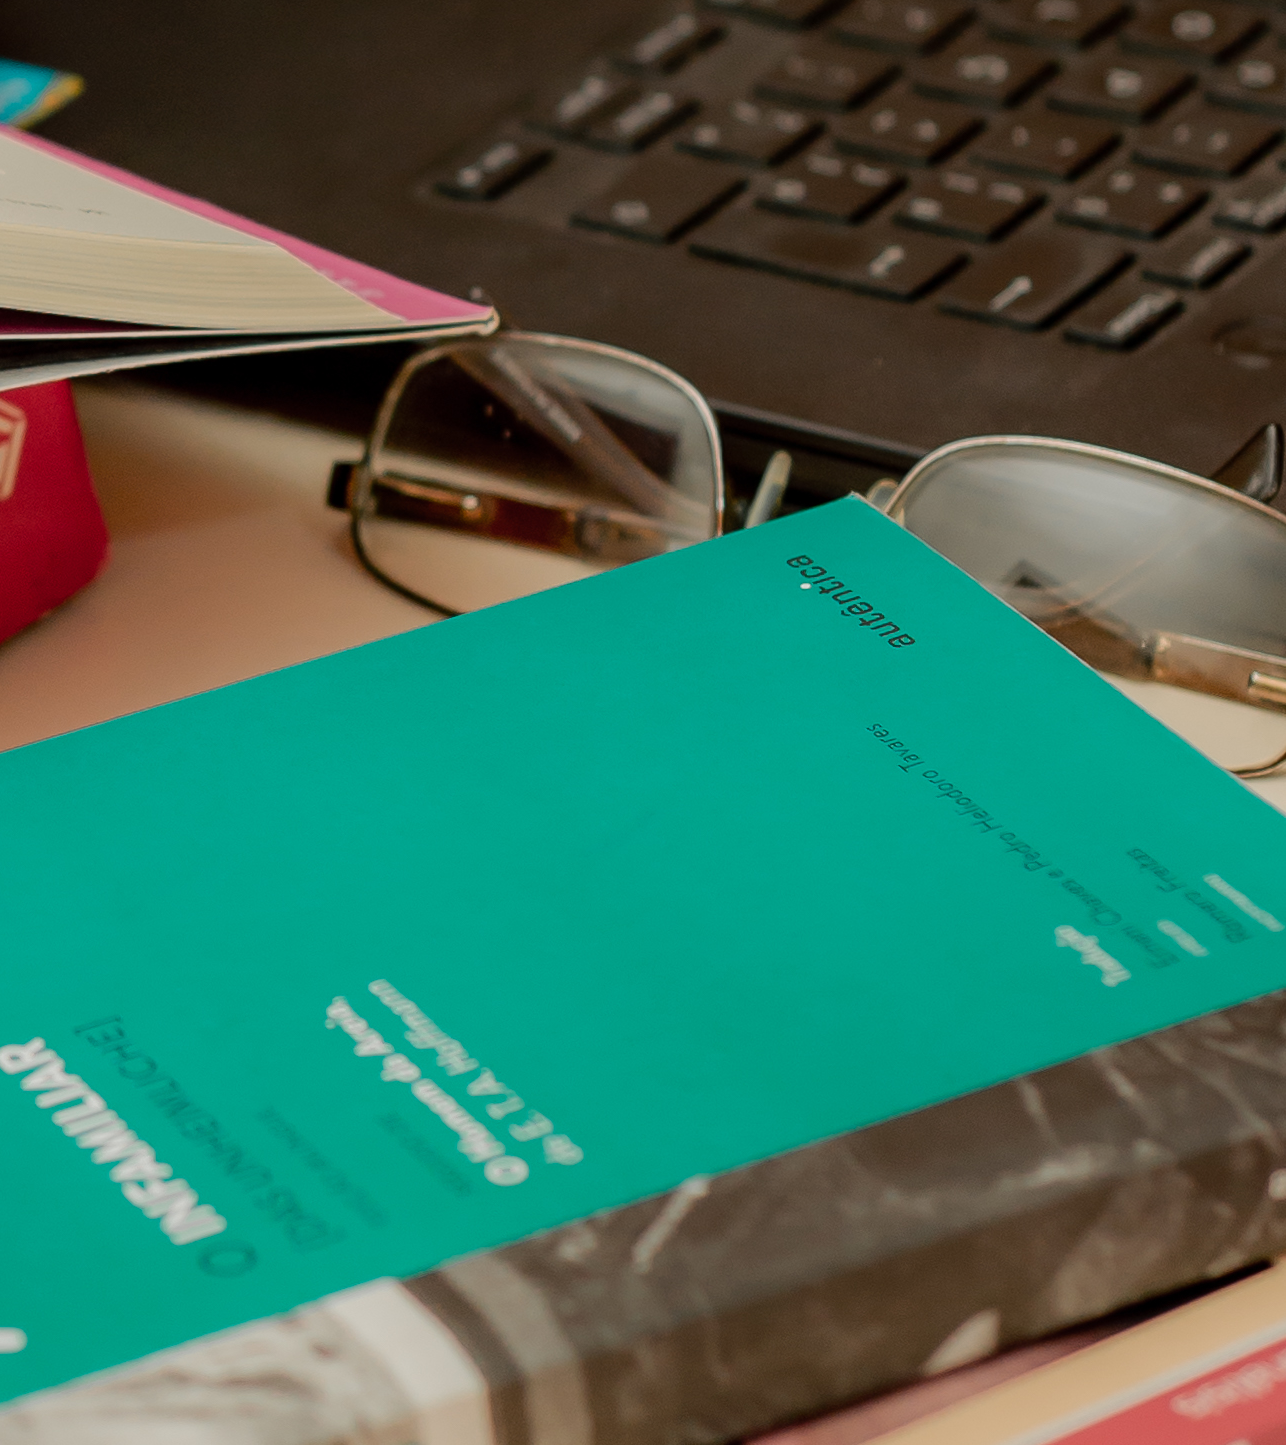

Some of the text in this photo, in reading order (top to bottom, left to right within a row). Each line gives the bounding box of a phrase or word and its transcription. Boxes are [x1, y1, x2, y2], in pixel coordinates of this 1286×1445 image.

[786, 554, 916, 649] autêntica
[866, 721, 923, 773] Tavares
[922, 768, 1004, 835] Heliodoro
[999, 830, 1052, 873] Pedro
